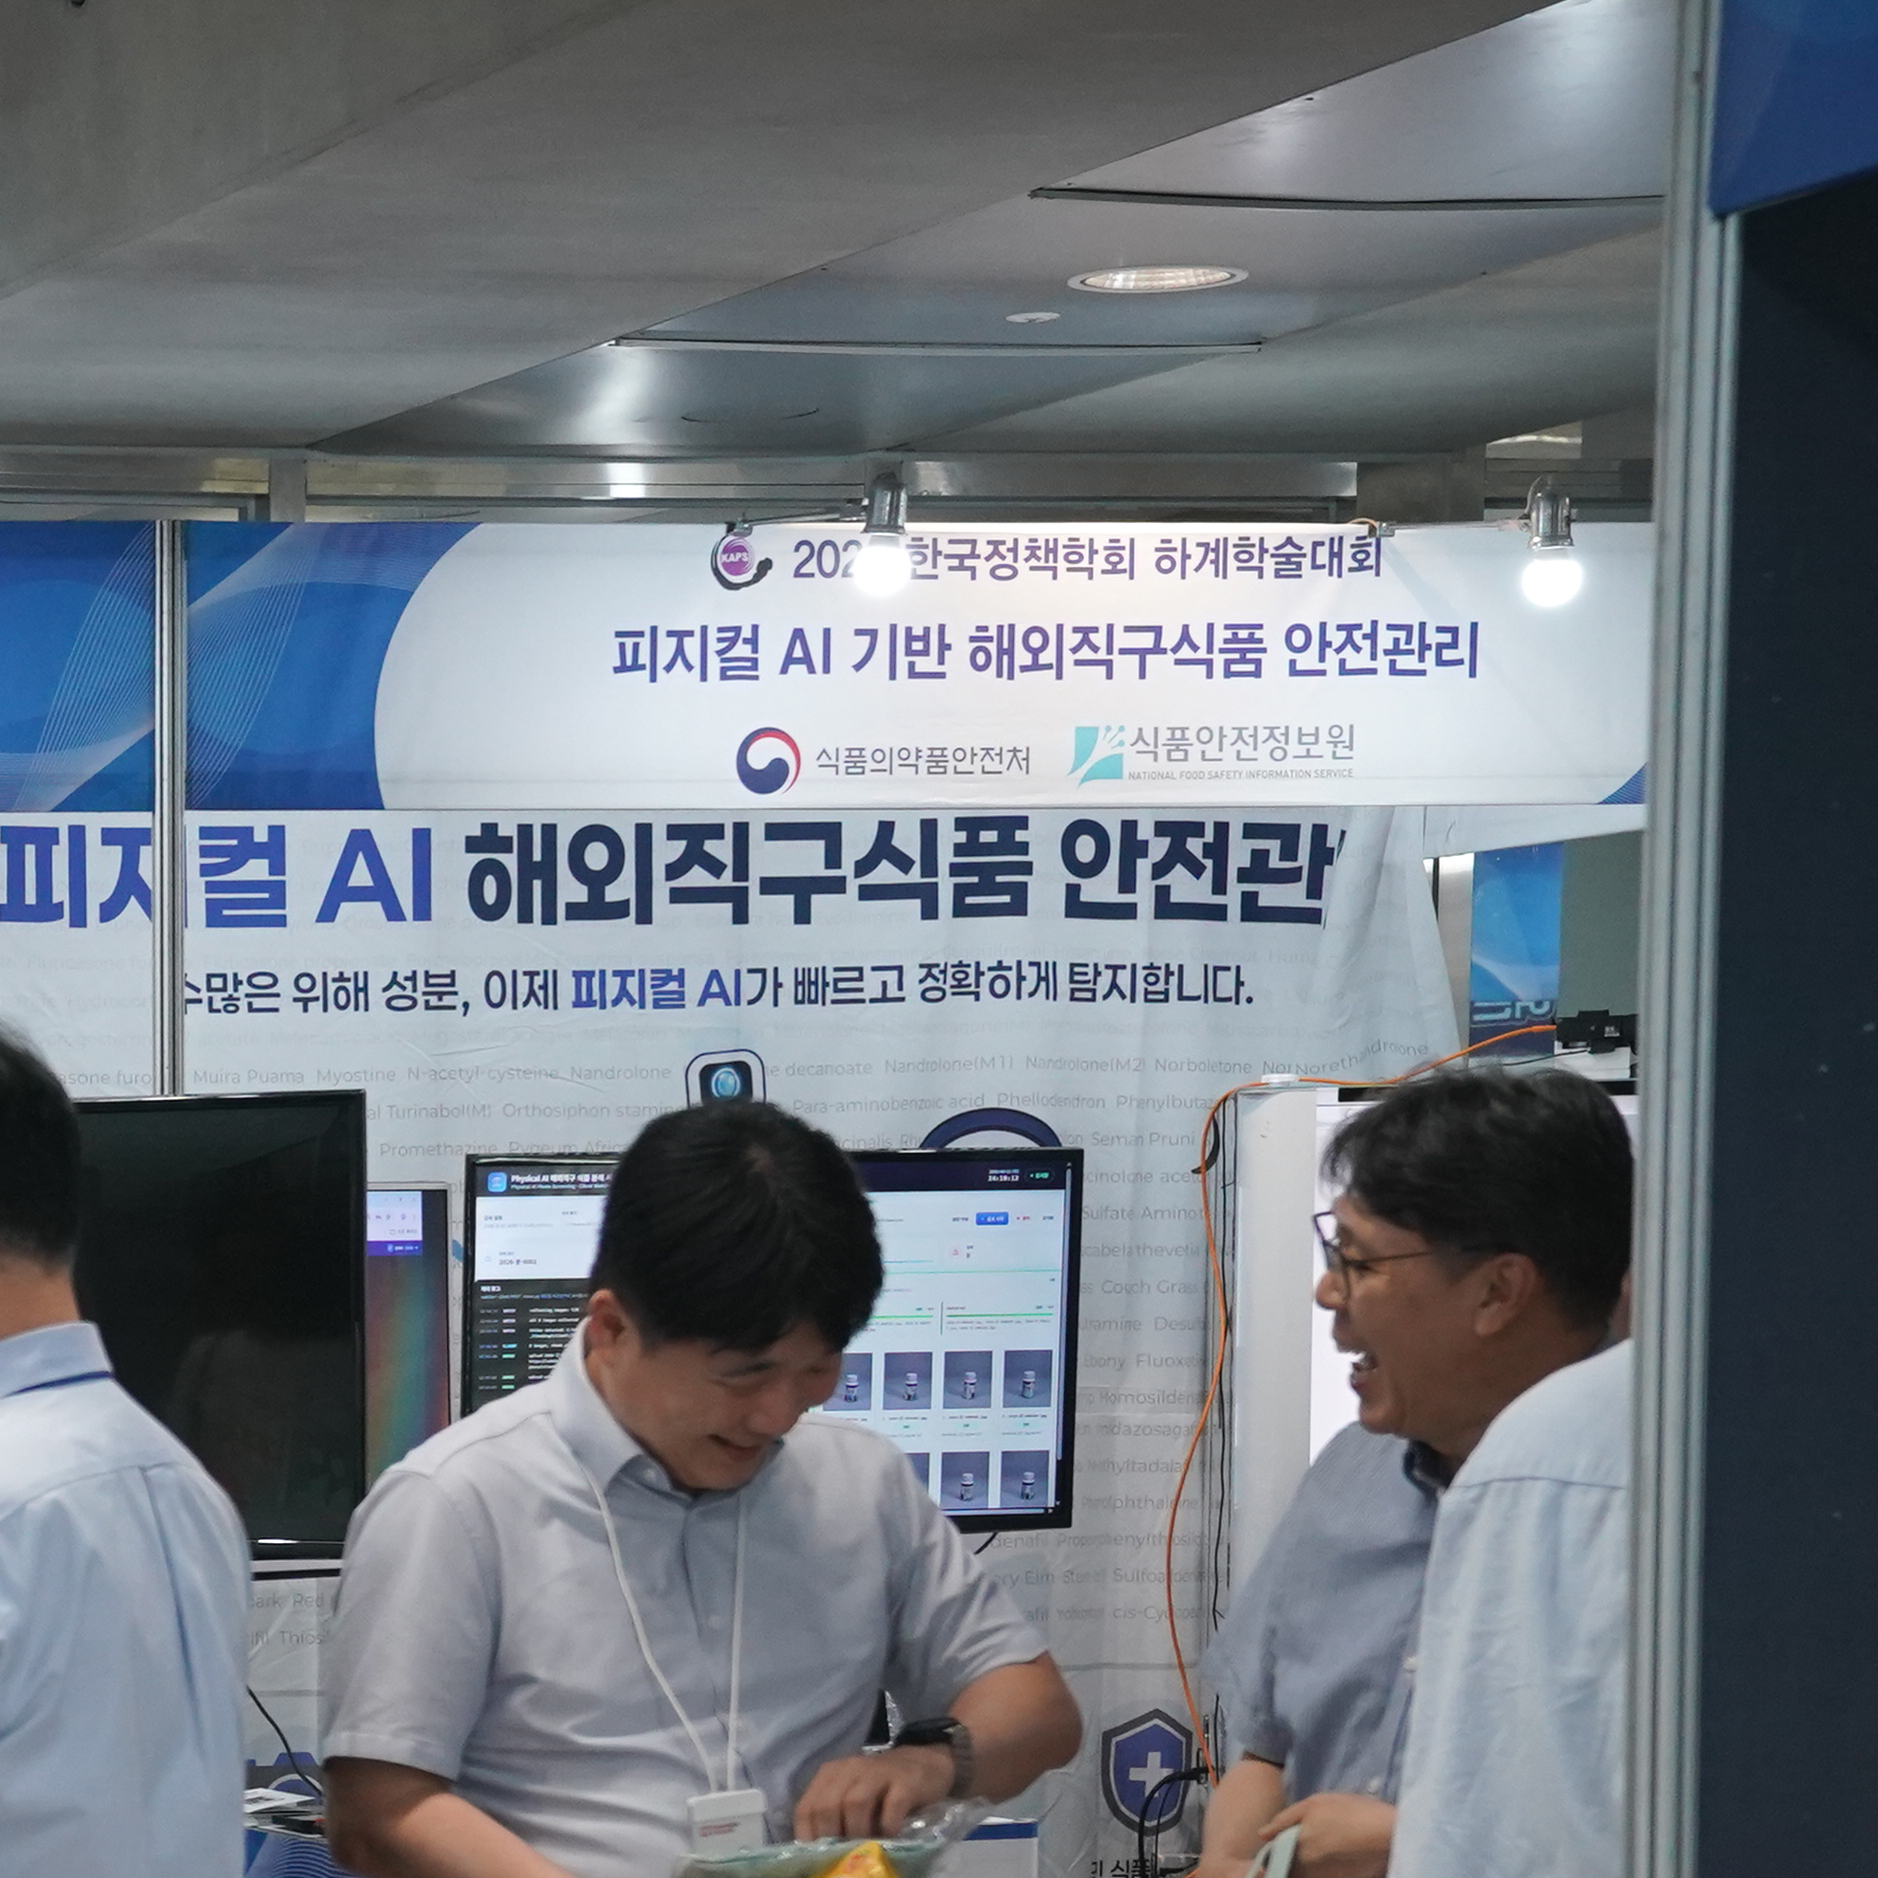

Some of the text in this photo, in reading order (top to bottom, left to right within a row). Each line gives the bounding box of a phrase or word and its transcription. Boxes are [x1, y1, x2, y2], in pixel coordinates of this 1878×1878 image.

[718, 549, 750, 565] KAPS
[1154, 536, 1383, 579] 하계학술대회
[612, 620, 1478, 683] 피지컬 AI 기반 해외직구식품 안전관리
[817, 724, 1353, 775] 식품의약품안전처 식품안전정보원
[315, 828, 432, 923] AI
[465, 814, 1035, 927] 해외직구식품
[293, 960, 1253, 1016] 위해 성분, 이제 피지컬 AI가 빠르고 정확하게 탐지합니다.
